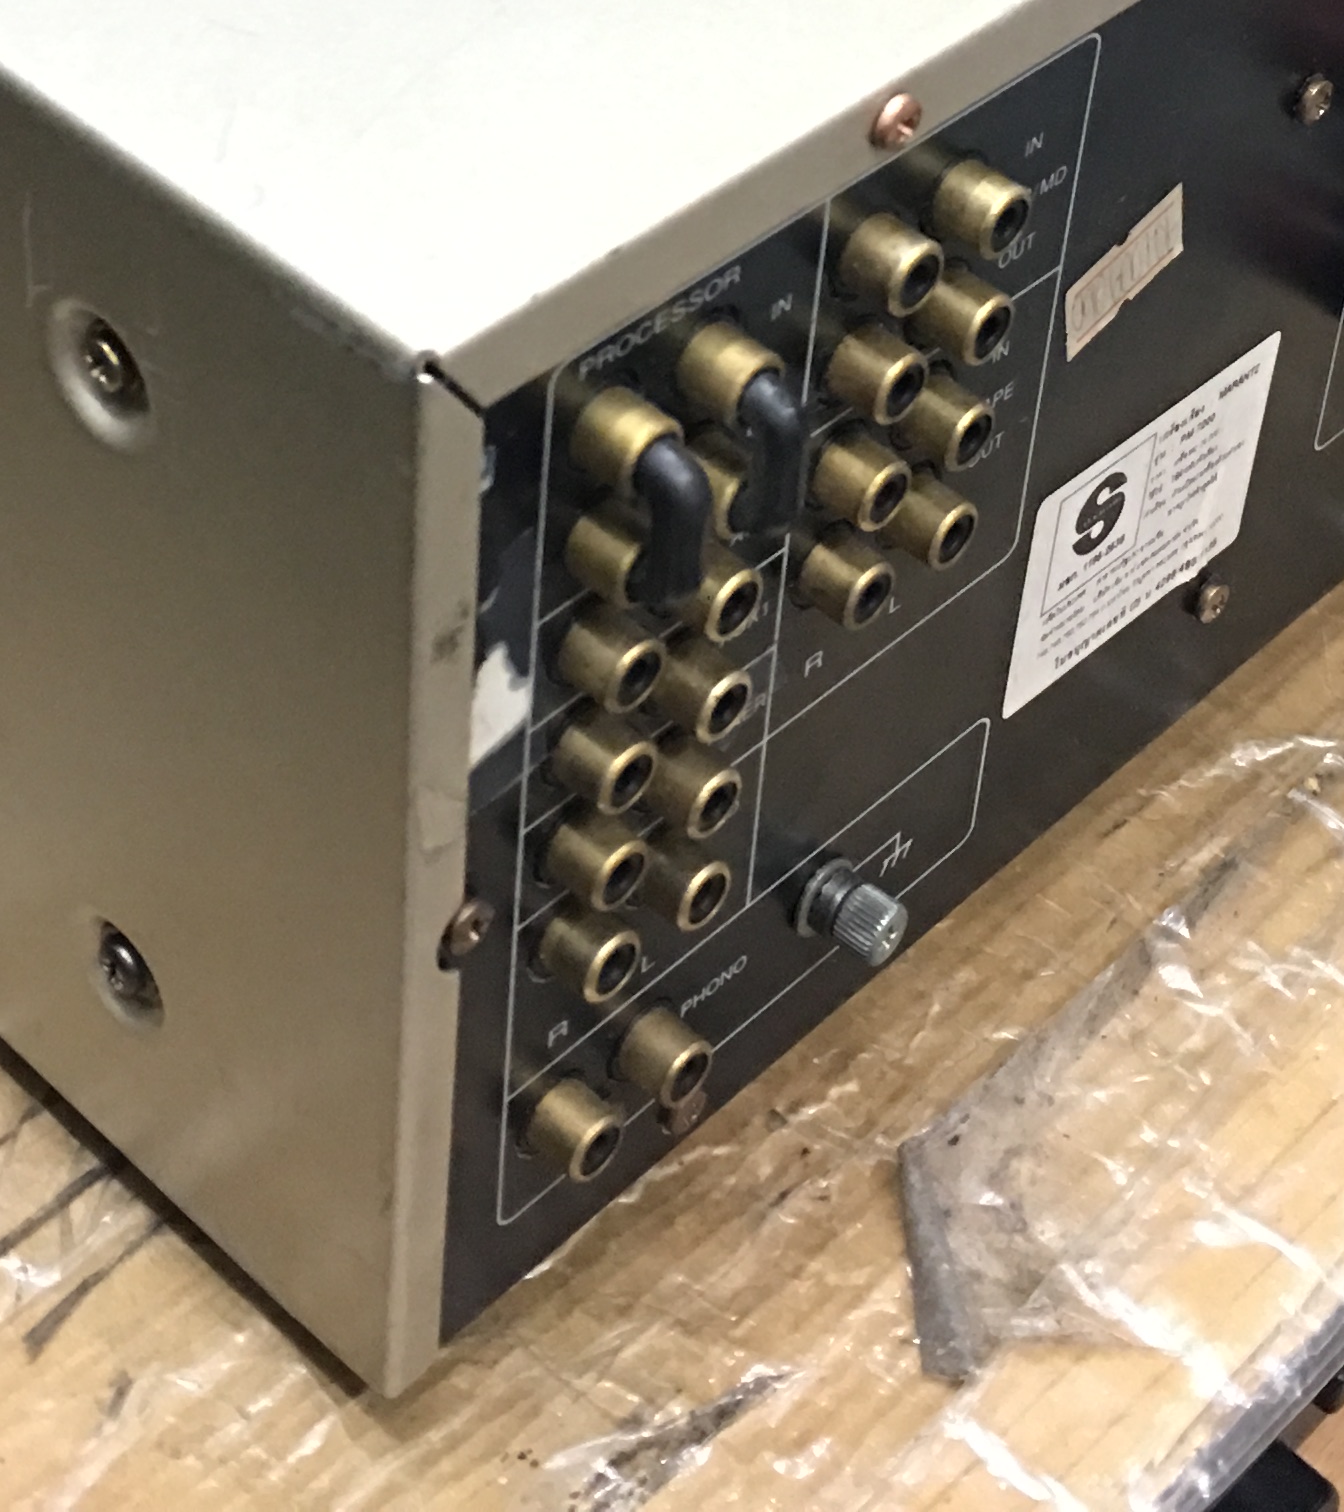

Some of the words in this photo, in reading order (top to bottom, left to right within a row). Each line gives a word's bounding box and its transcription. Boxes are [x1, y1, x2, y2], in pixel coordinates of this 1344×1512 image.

[1023, 131, 1045, 159] IN
[997, 231, 1038, 270] OUT
[769, 292, 794, 321] IN
[578, 265, 743, 382] PROCESSOR
[887, 595, 903, 615] L
[803, 649, 824, 679] R
[639, 955, 656, 975] L
[679, 954, 748, 1019] PHONO
[547, 1019, 570, 1049] R
